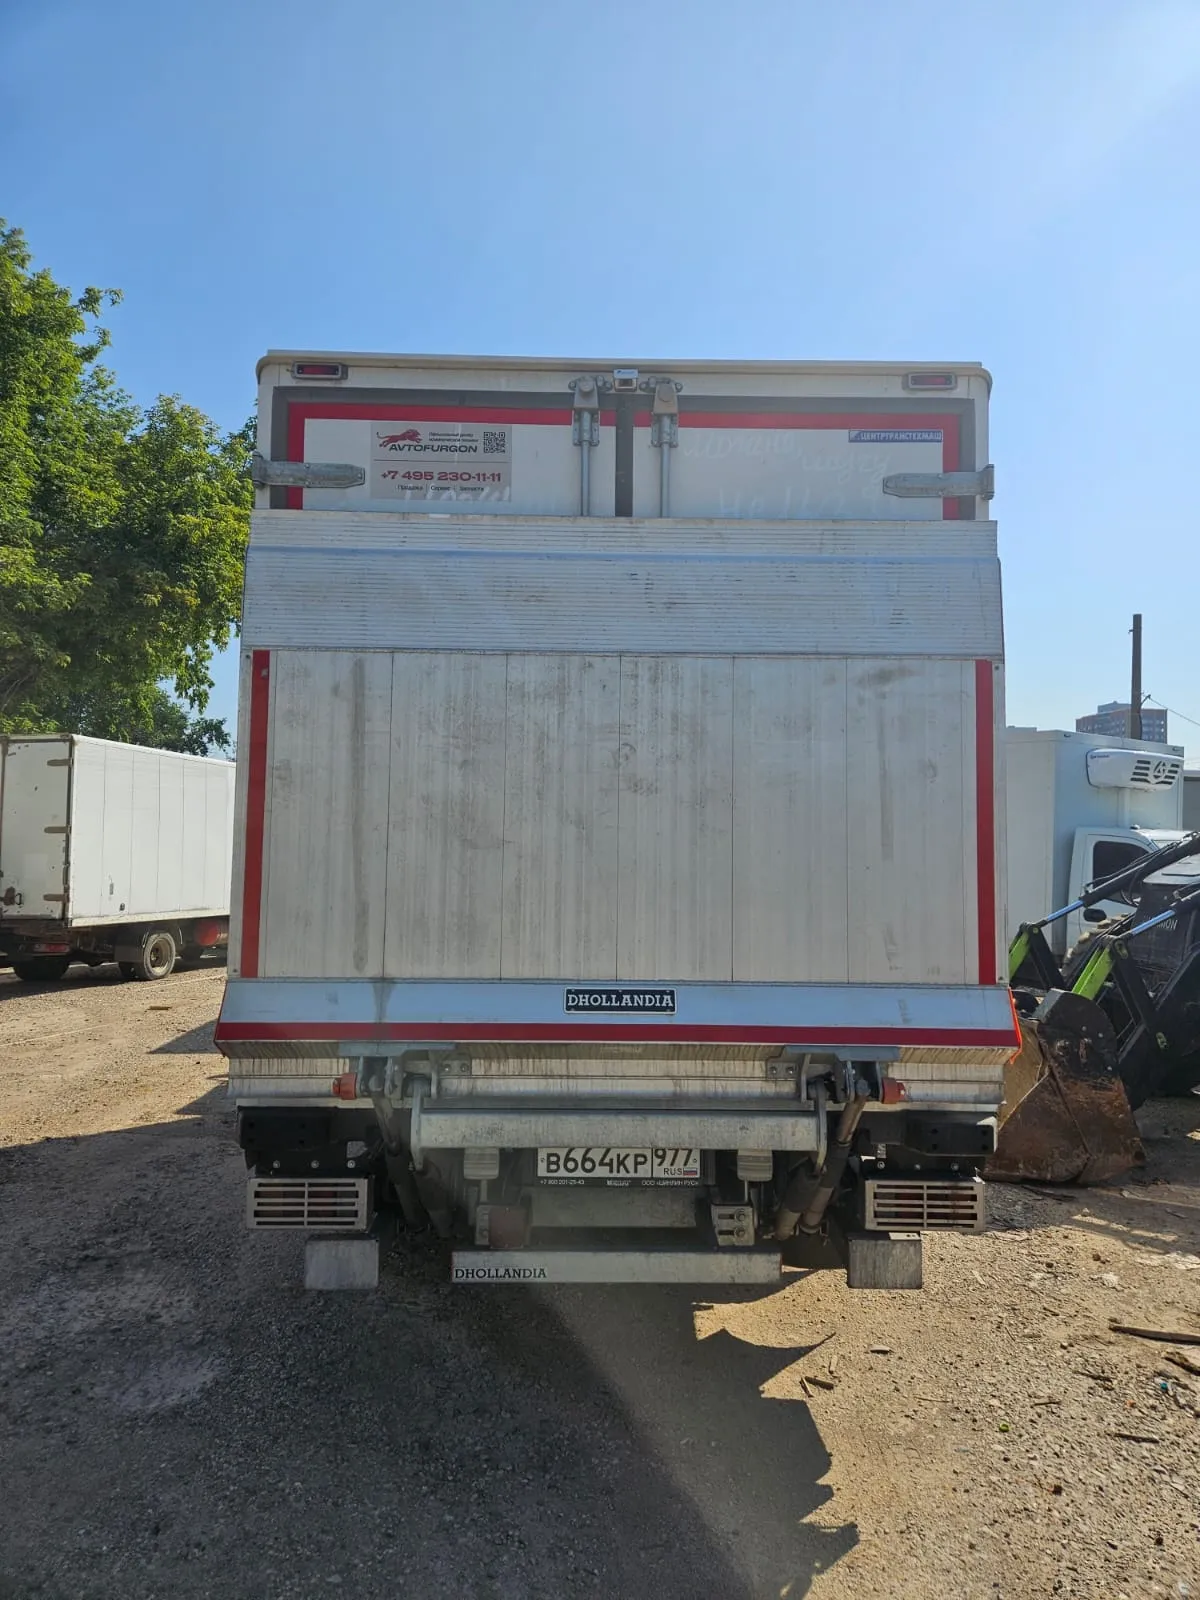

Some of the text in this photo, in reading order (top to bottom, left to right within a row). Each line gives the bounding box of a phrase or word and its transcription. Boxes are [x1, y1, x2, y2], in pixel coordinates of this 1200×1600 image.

[389, 444, 478, 453] AVTOFURGON
[381, 471, 501, 482] +7 495 230-11-11
[567, 994, 673, 1007] DHOLLANDIA
[654, 1149, 693, 1167] 977
[663, 1167, 683, 1176] RUS
[455, 1268, 546, 1279] DHOLLANDIA
